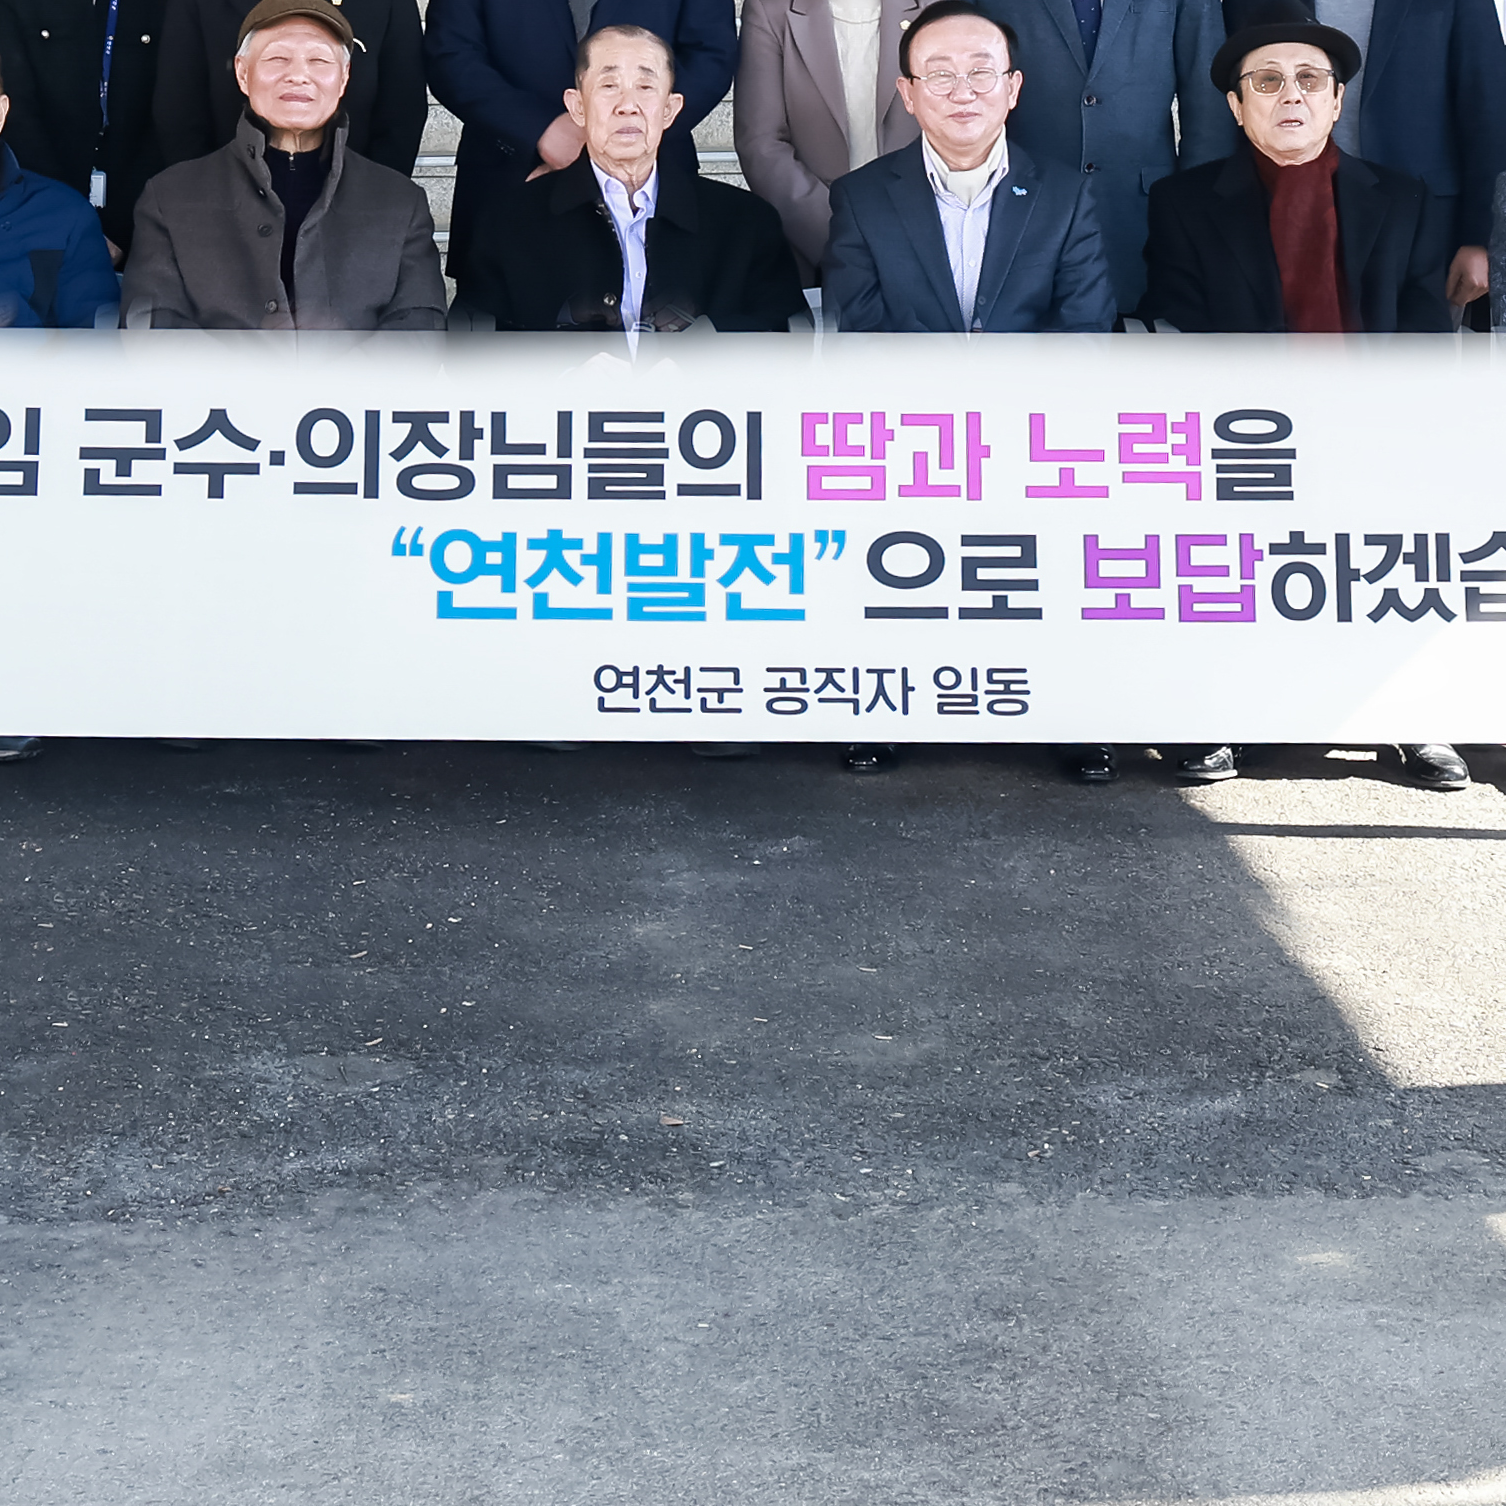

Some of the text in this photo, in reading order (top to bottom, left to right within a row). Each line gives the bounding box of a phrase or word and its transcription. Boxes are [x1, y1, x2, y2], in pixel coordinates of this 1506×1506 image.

[78, 406, 763, 502] 군수·의장님들의
[799, 410, 991, 502] 땀과
[1024, 408, 1298, 502] 노력을
[592, 663, 1032, 717] 연천군 공직자 일동
